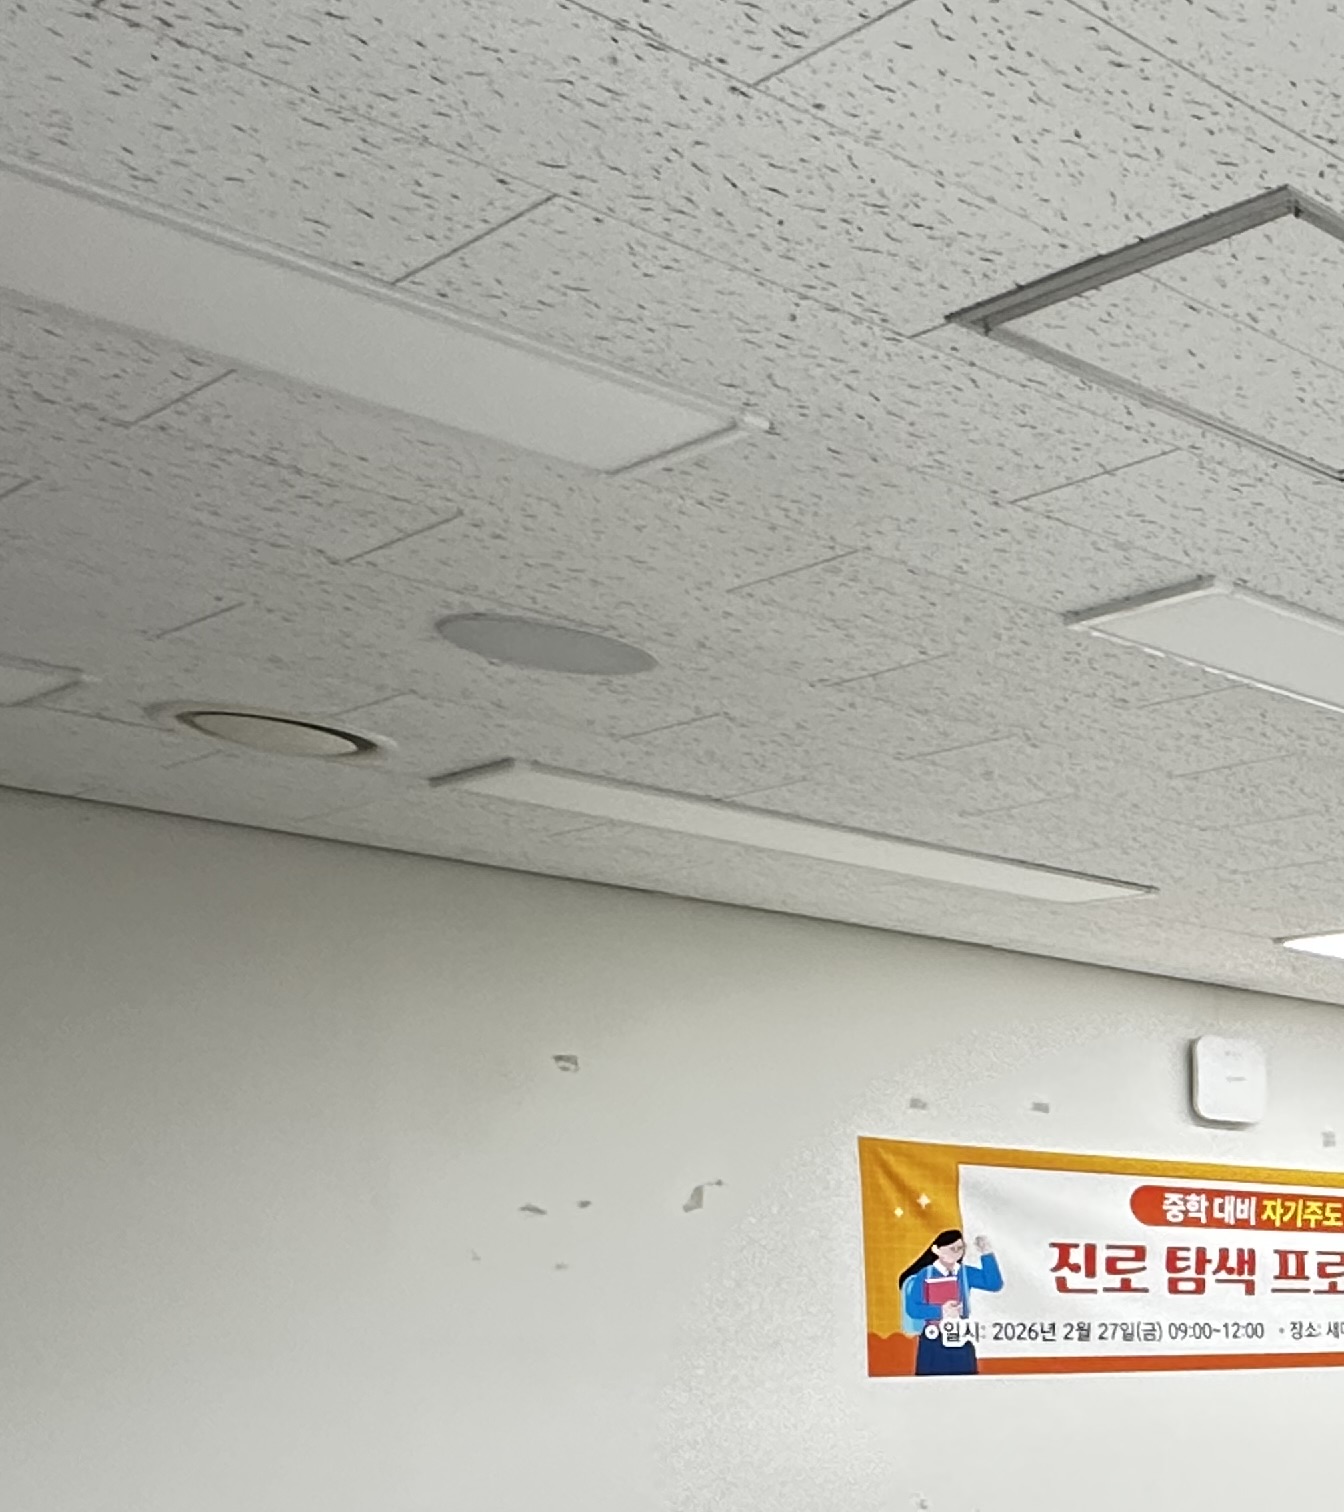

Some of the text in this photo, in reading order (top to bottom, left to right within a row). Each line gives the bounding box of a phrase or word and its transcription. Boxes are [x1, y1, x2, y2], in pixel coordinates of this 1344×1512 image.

[1162, 1193, 1207, 1223] 중학
[1213, 1195, 1256, 1225] 대비
[1261, 1198, 1343, 1229] 자기주도
[1048, 1242, 1150, 1294] 진로
[1164, 1246, 1256, 1296] 탐색
[942, 1322, 986, 1343] 일시:
[992, 1321, 1057, 1342] 2026년
[1062, 1321, 1091, 1342] 2월
[1098, 1320, 1163, 1342] 27일(금)
[1168, 1322, 1265, 1341] 09:00~12:00
[1289, 1320, 1322, 1339] 장소:
